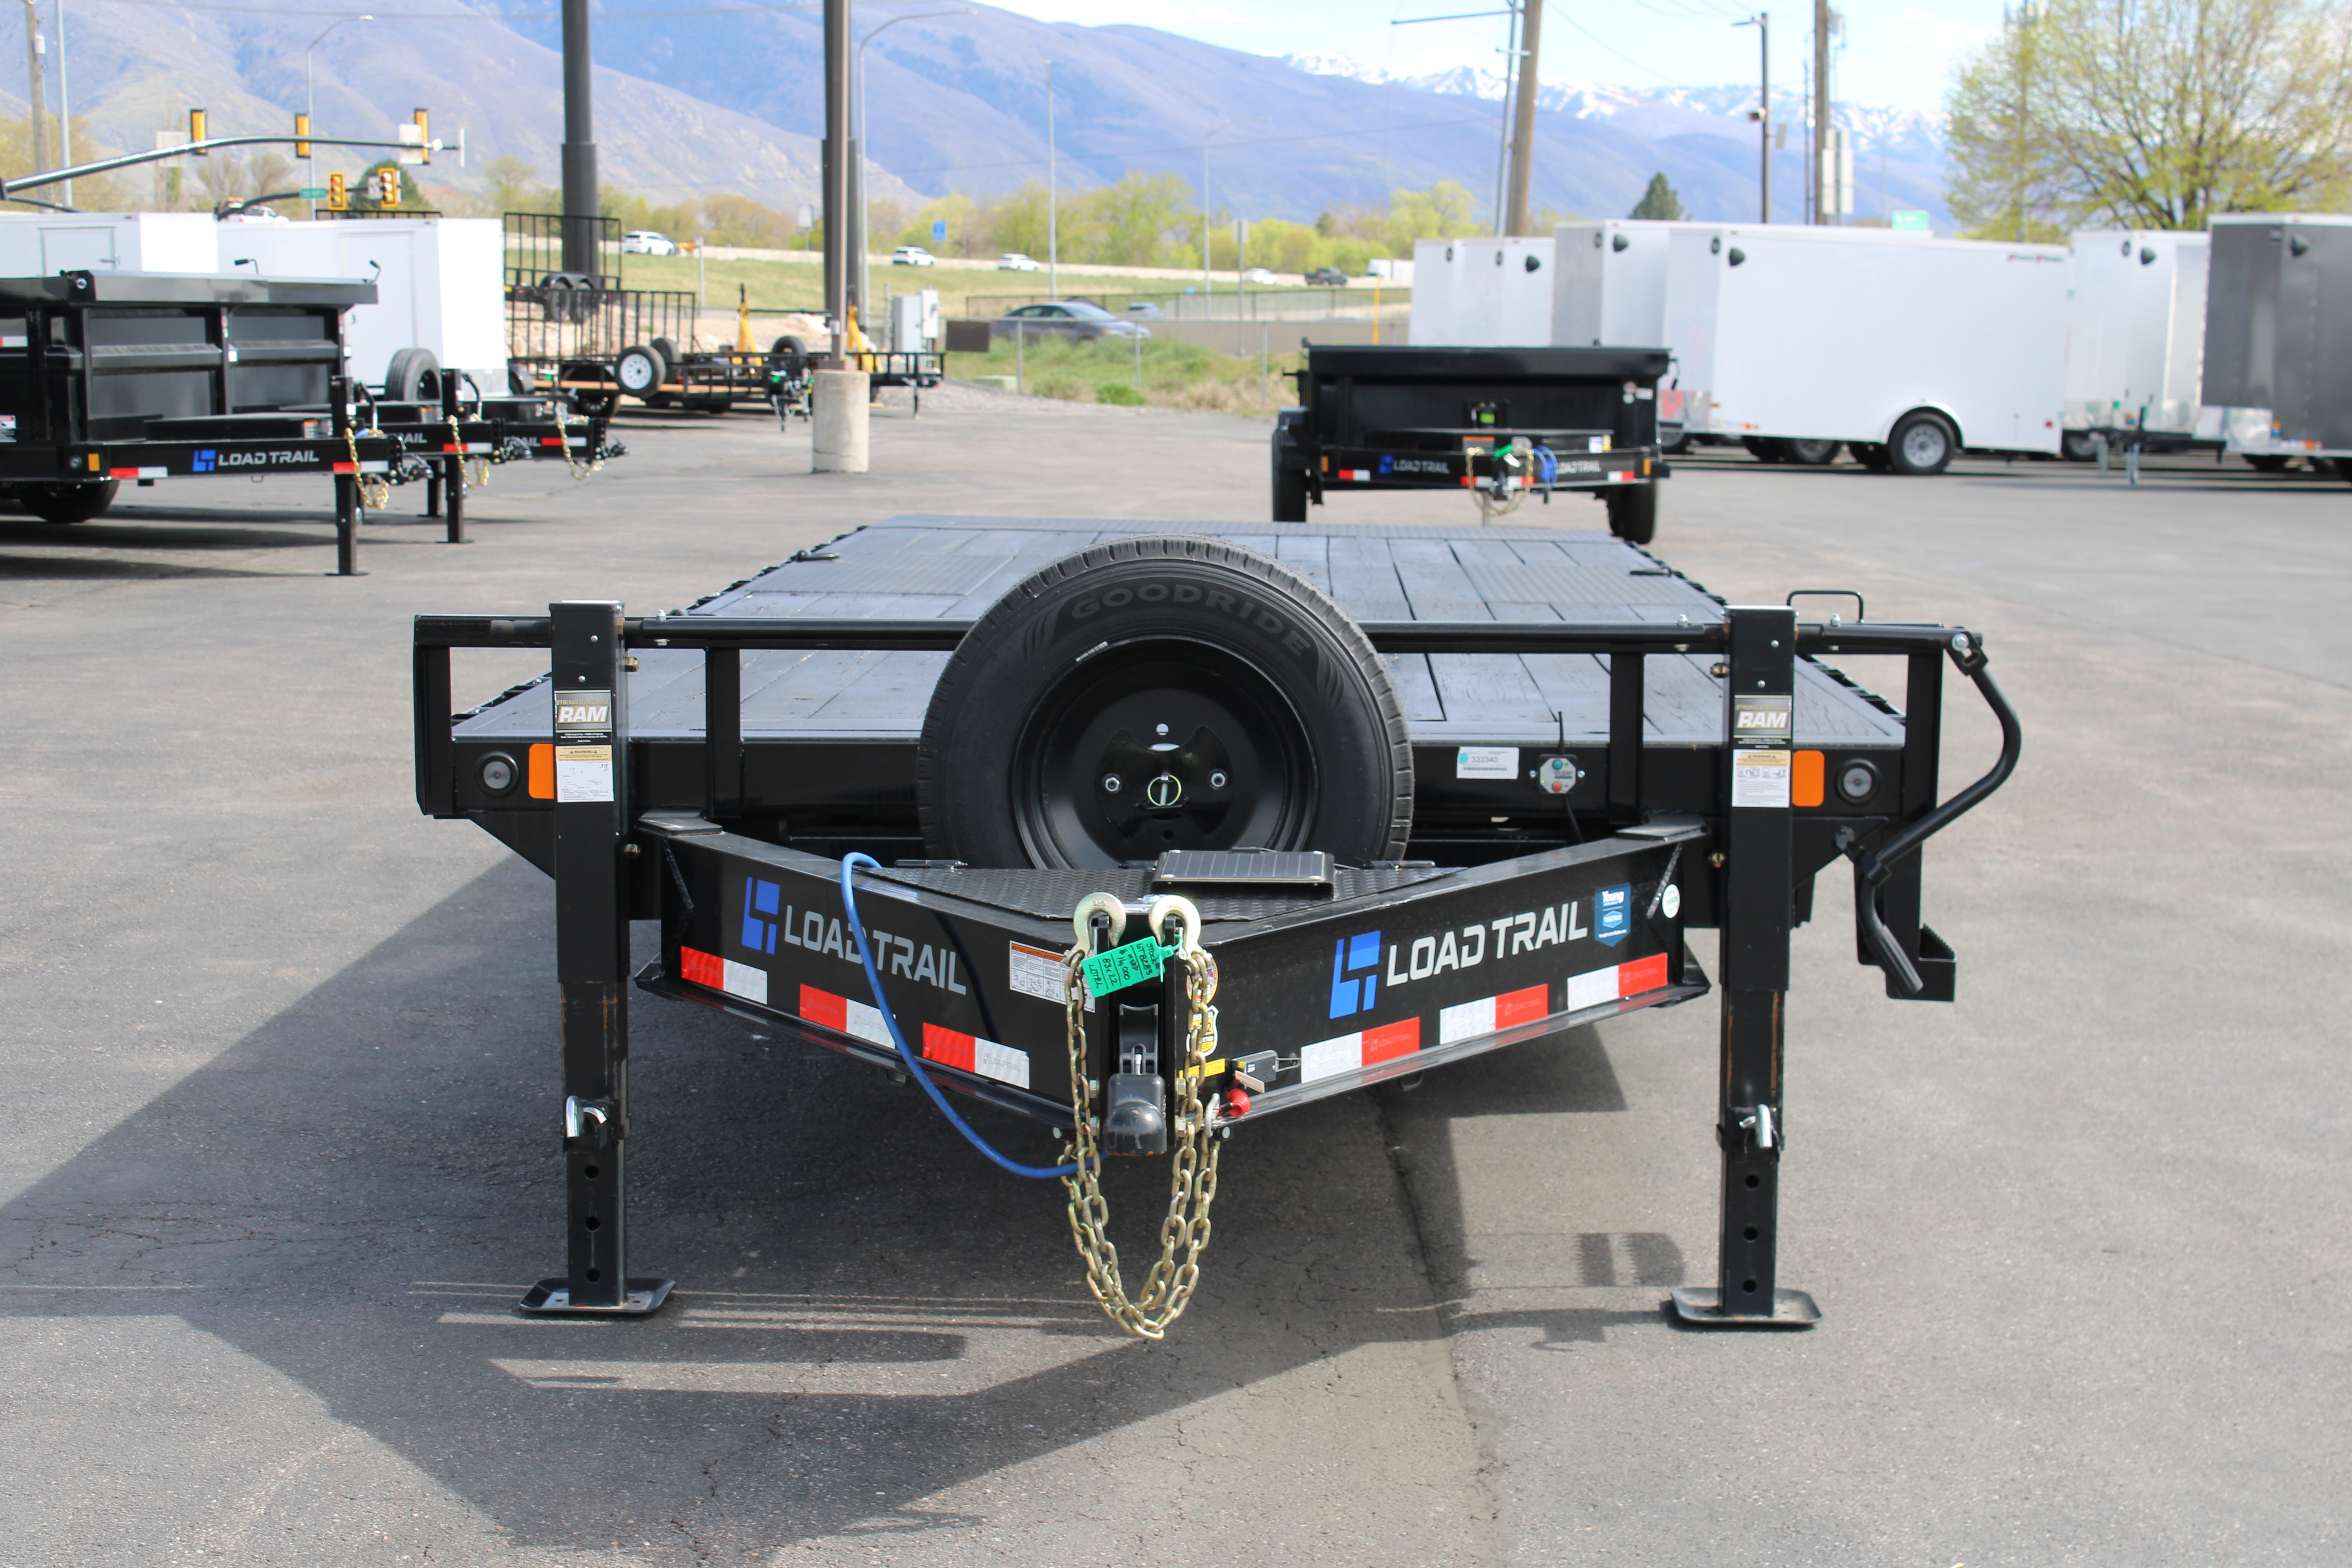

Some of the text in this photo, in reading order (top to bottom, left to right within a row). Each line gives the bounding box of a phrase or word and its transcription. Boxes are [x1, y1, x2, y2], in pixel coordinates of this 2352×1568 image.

[218, 450, 320, 466] LOAD TRAIL
[1393, 459, 1450, 474] LOAD TRAIL
[1578, 460, 1601, 473] TRAIL
[1071, 584, 1311, 656] GOODRIDE
[558, 706, 609, 723] RAM
[1737, 711, 1788, 728] RAM
[1602, 890, 1625, 904] Young
[1387, 901, 1588, 987] LOAD TRAIL
[873, 929, 967, 995] TRAIL
